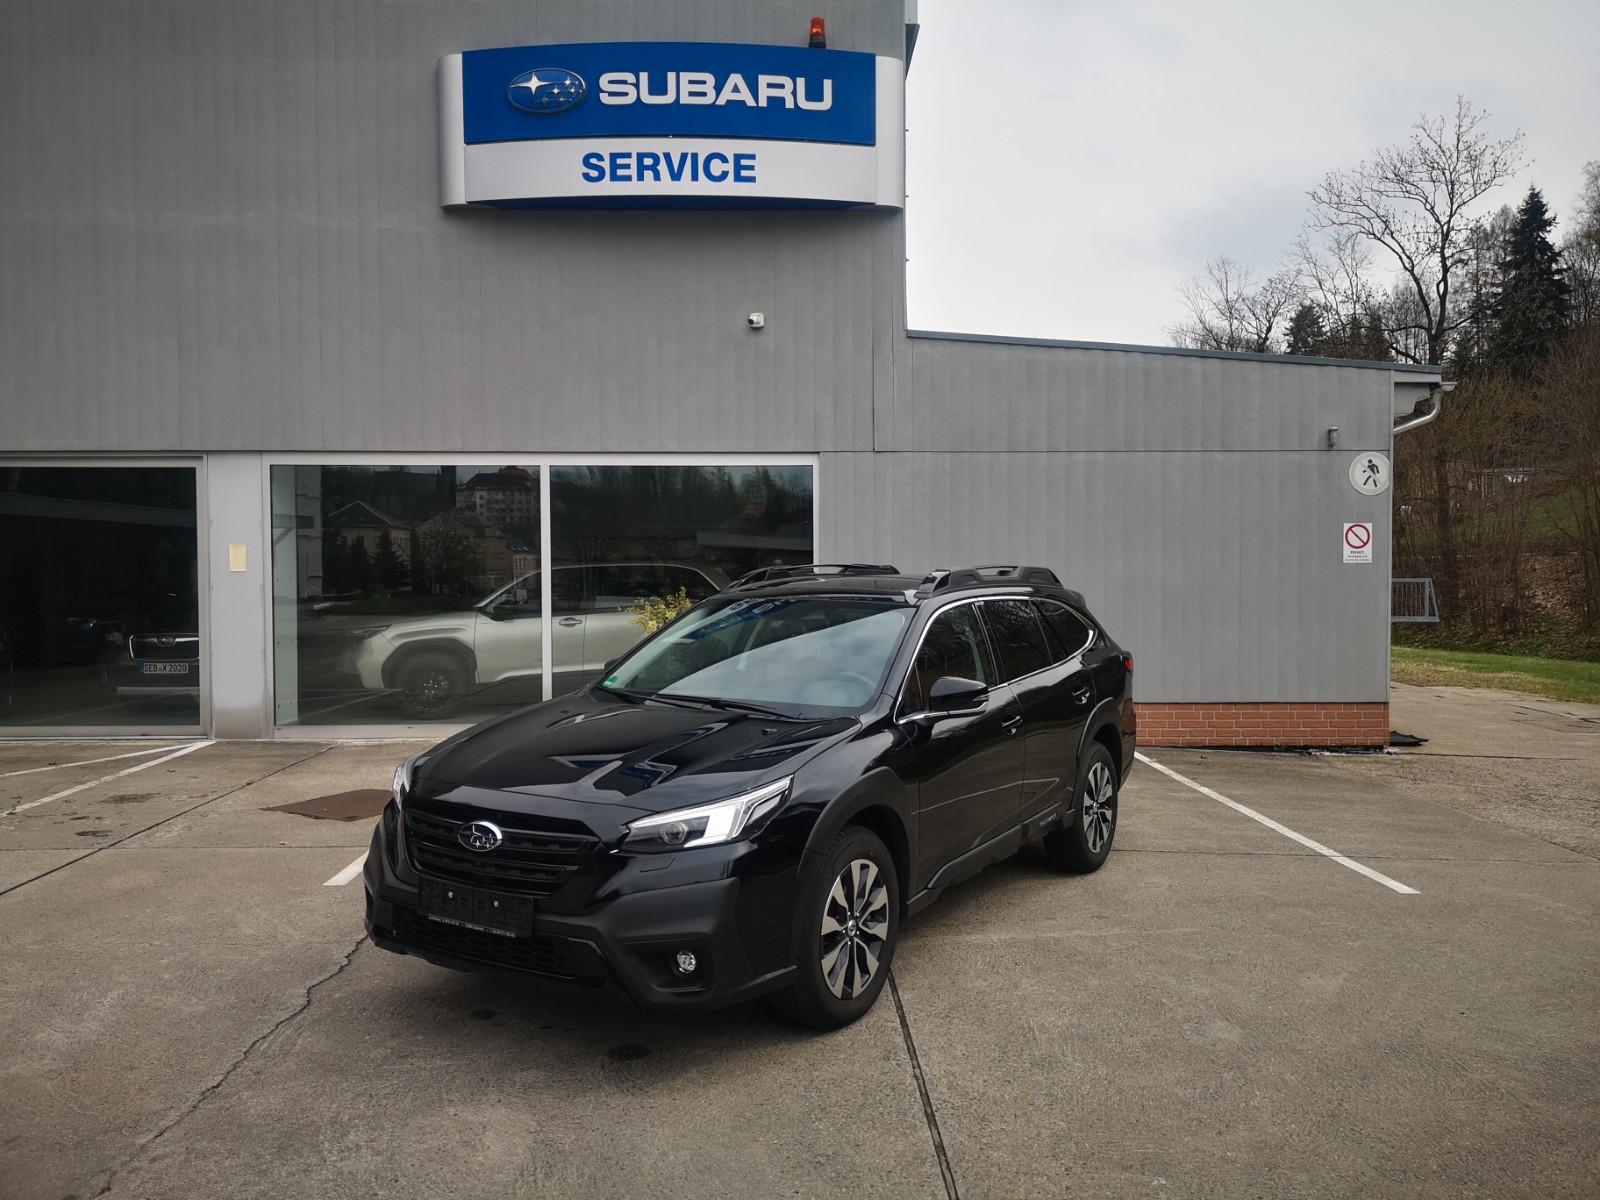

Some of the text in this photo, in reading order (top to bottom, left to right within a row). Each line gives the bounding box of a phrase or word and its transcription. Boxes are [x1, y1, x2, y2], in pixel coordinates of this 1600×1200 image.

[599, 72, 833, 111] SUBARU
[582, 152, 757, 183] SERVICE
[168, 663, 187, 673] 2020
